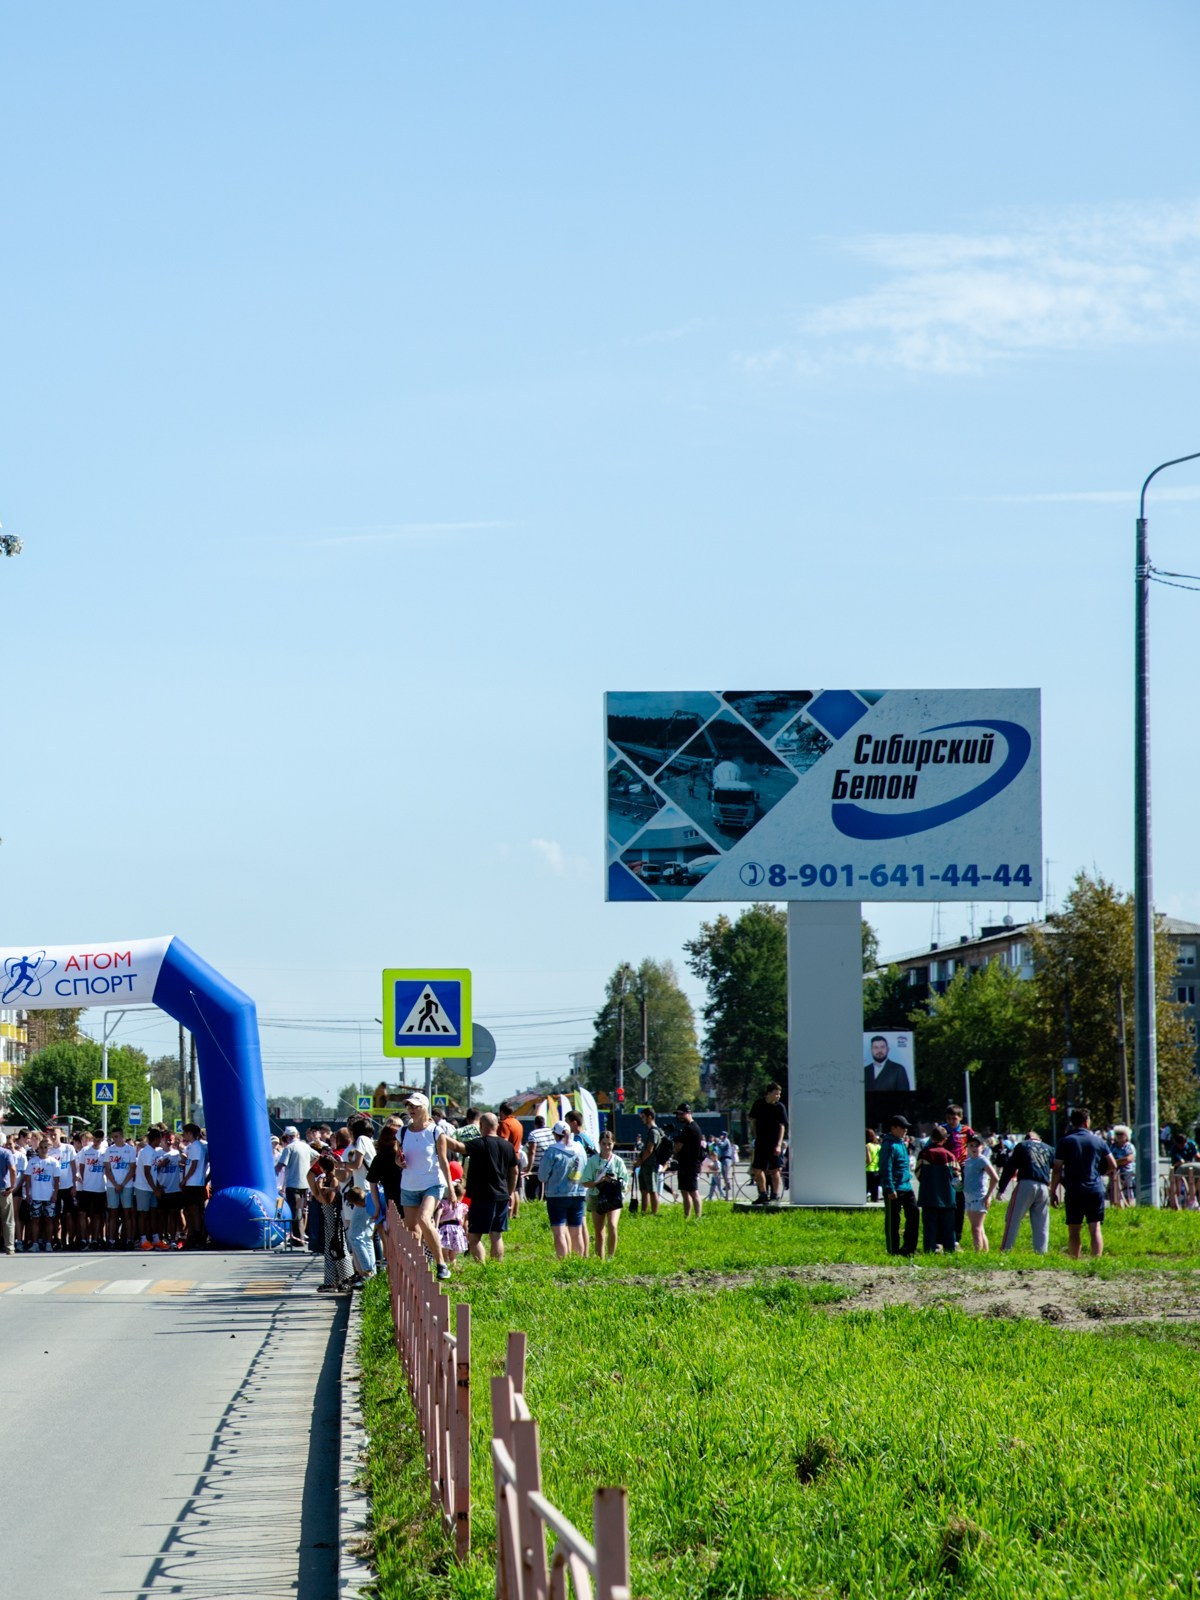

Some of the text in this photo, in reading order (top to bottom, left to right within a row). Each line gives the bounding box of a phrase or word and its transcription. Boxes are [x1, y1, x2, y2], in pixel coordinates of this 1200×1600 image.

[853, 733, 994, 771] Сибирский
[831, 769, 918, 800] Бетон
[767, 863, 1033, 887] 8-901-641-44-44
[64, 951, 131, 972] АТОМ
[55, 973, 137, 997] СПОРТ
